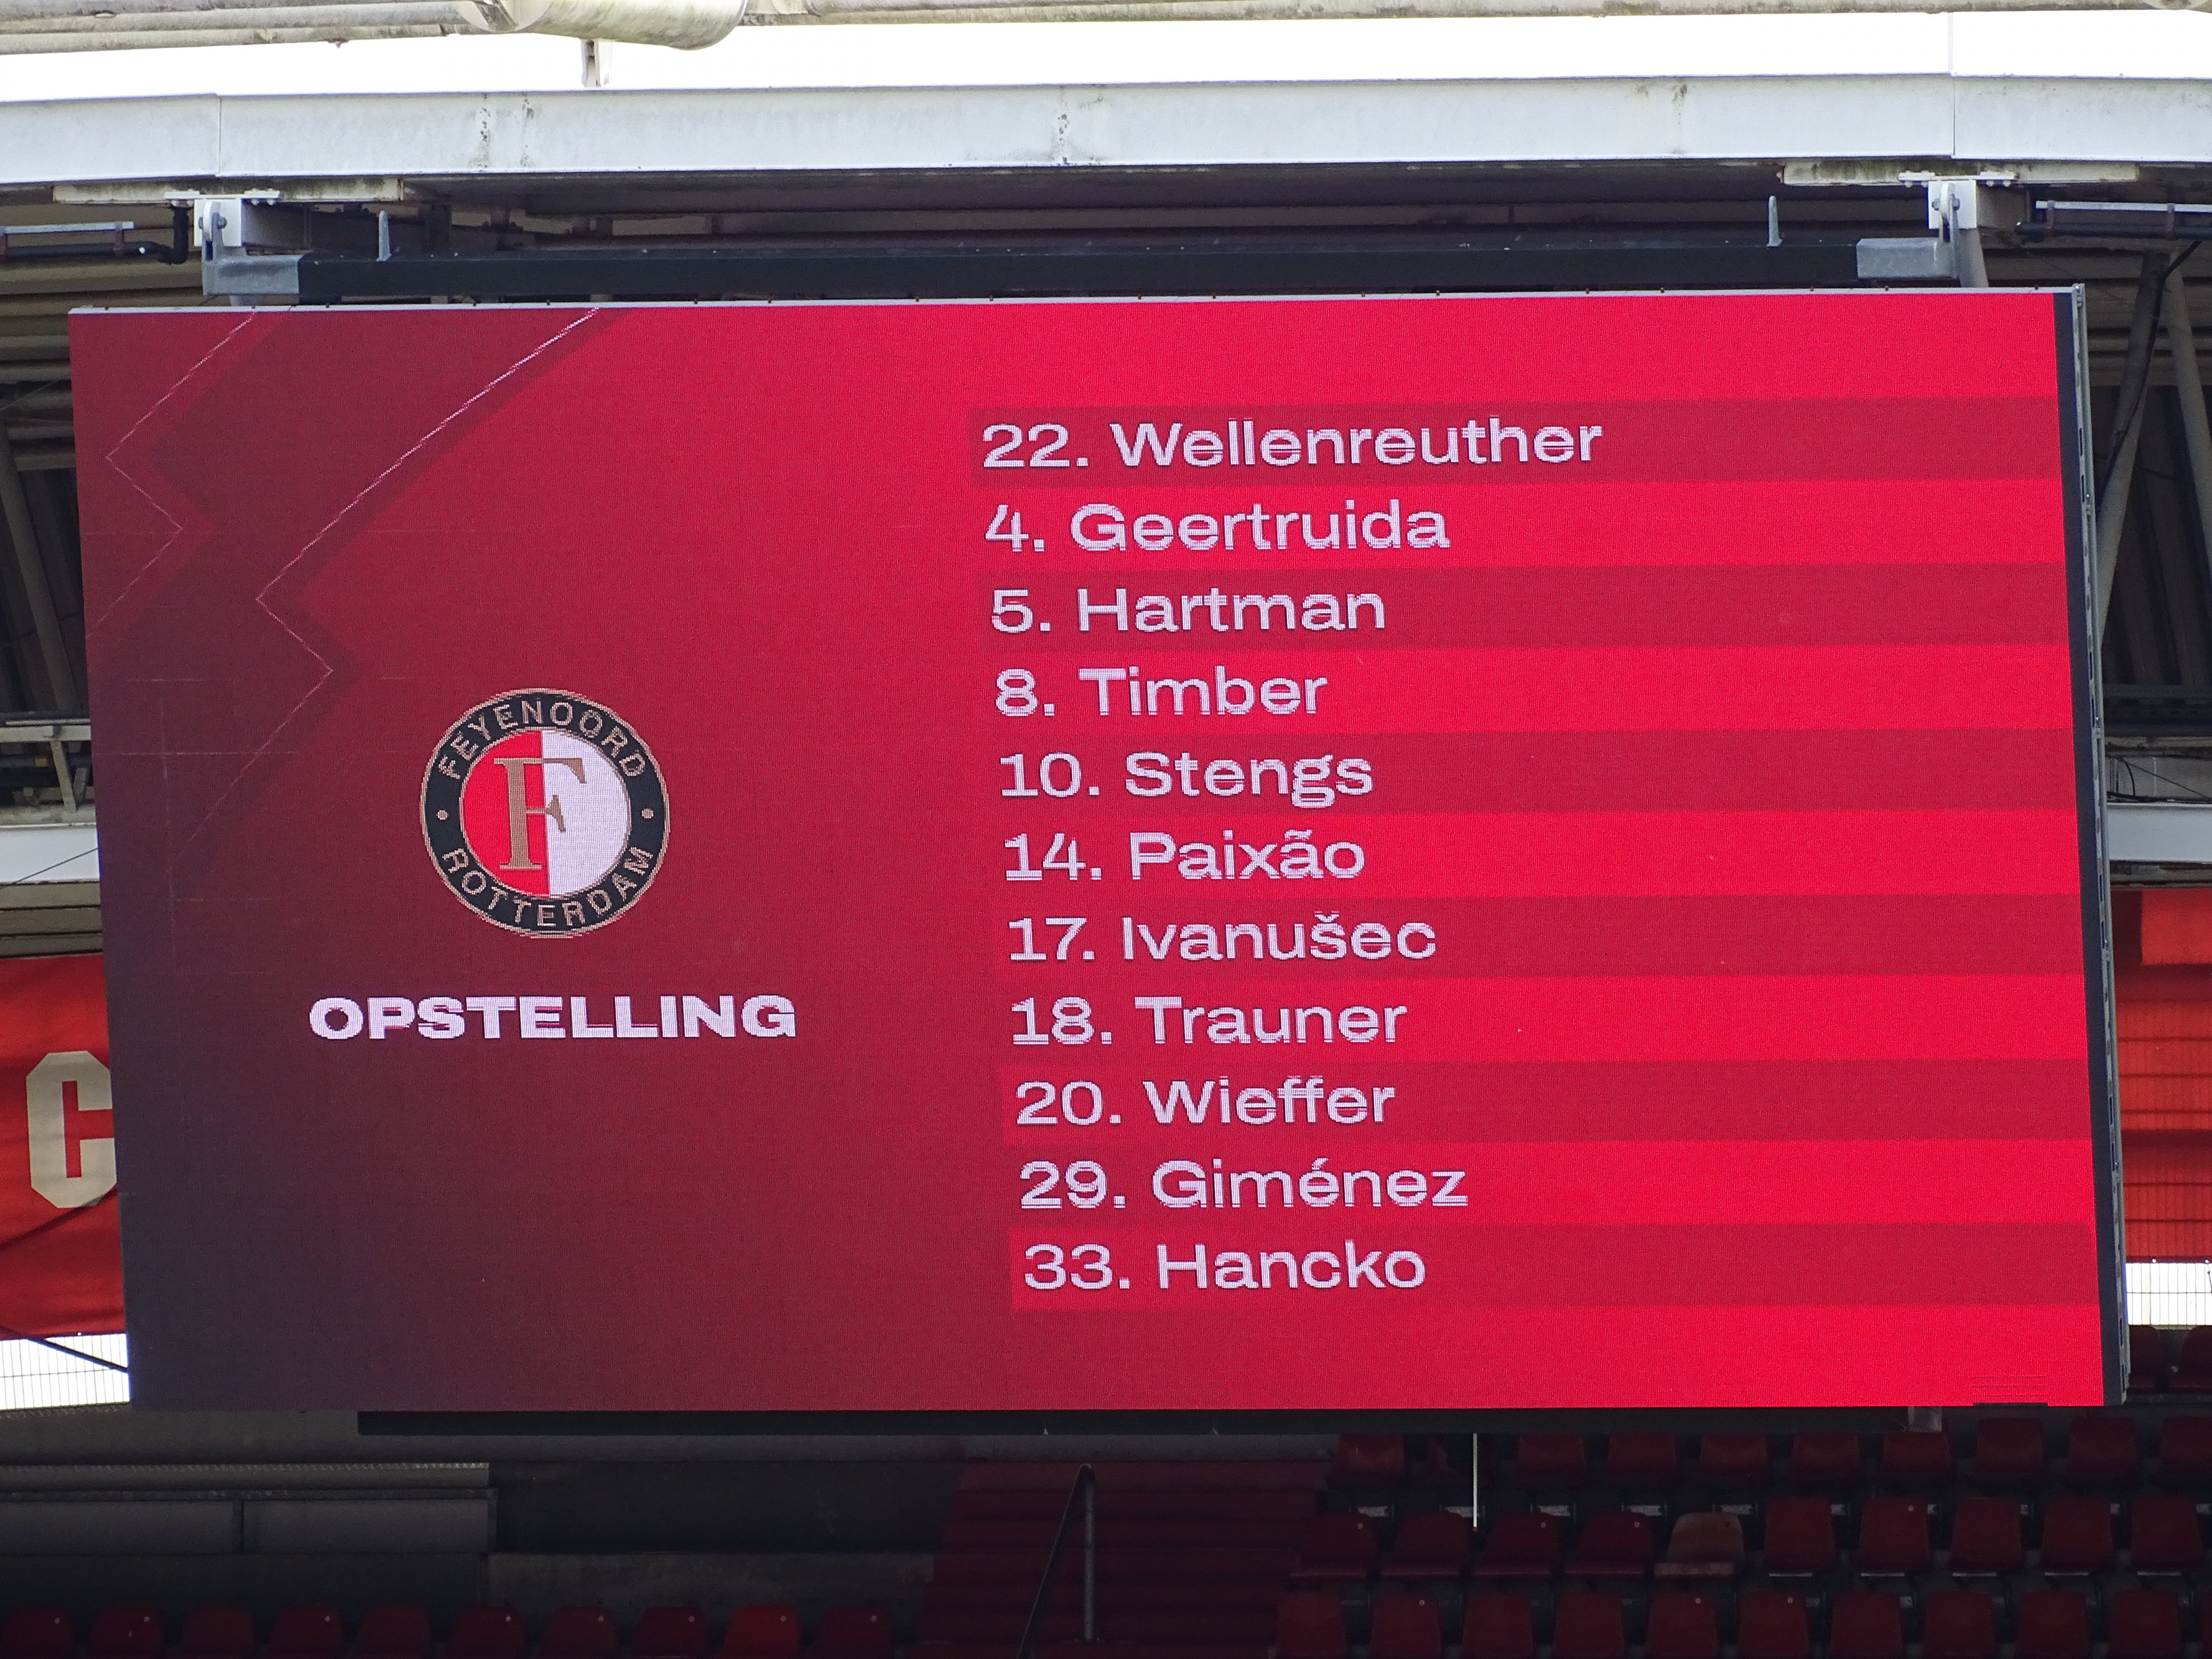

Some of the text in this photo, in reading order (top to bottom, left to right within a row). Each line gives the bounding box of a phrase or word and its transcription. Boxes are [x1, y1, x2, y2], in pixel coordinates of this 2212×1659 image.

[982, 417, 1603, 467] 22. Wellenreuther
[985, 498, 1451, 552] 4. Geertruida
[991, 587, 1385, 634] 5. Hartman
[995, 665, 1328, 717] 8. Timber
[438, 700, 646, 779] FEYENOORD
[999, 751, 1373, 809] 10. Stengs
[493, 757, 588, 870] F
[1004, 829, 1365, 881] 14. Paixão
[442, 847, 654, 926] ROTTERDAM
[1008, 911, 1436, 961] 17. Ivanušec
[308, 995, 796, 1040] OPSTELLING
[1011, 995, 1407, 1045] 18. Trauner
[1016, 1075, 1396, 1125] 20. Wieffer
[1019, 1157, 1468, 1209] 29. Giménez
[1024, 1239, 1425, 1290] 33. Hancko
